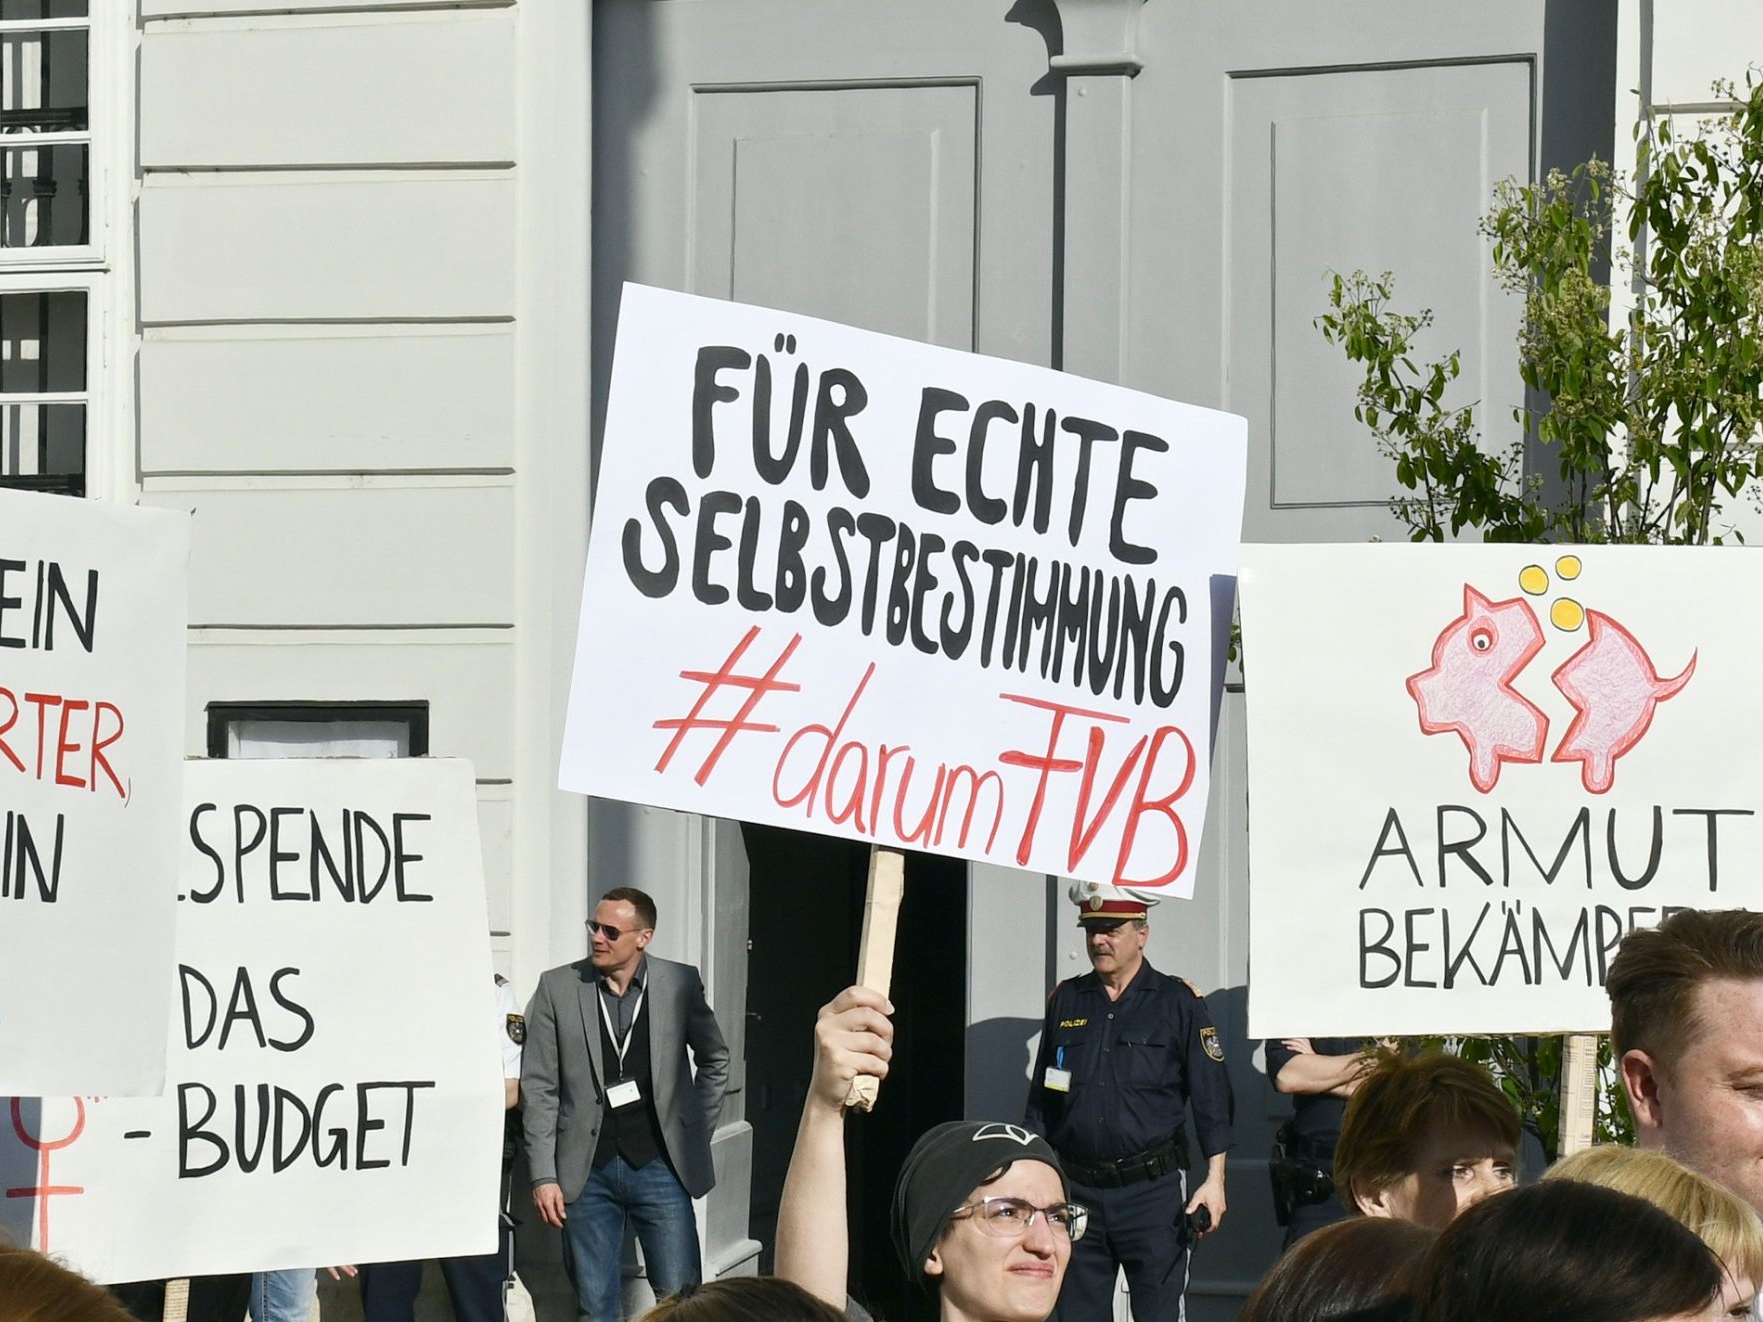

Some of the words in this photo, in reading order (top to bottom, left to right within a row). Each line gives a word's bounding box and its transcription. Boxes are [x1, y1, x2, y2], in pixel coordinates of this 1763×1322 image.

[691, 332, 870, 499] FÜR
[911, 386, 1169, 565] ECHTE
[621, 475, 1188, 709] SELBSTBESTIMMUNG
[177, 803, 434, 903] SPENDE
[1359, 803, 1756, 892] ARMUT
[1358, 899, 1696, 989] BEKÄMP
[178, 964, 315, 1052] DAS
